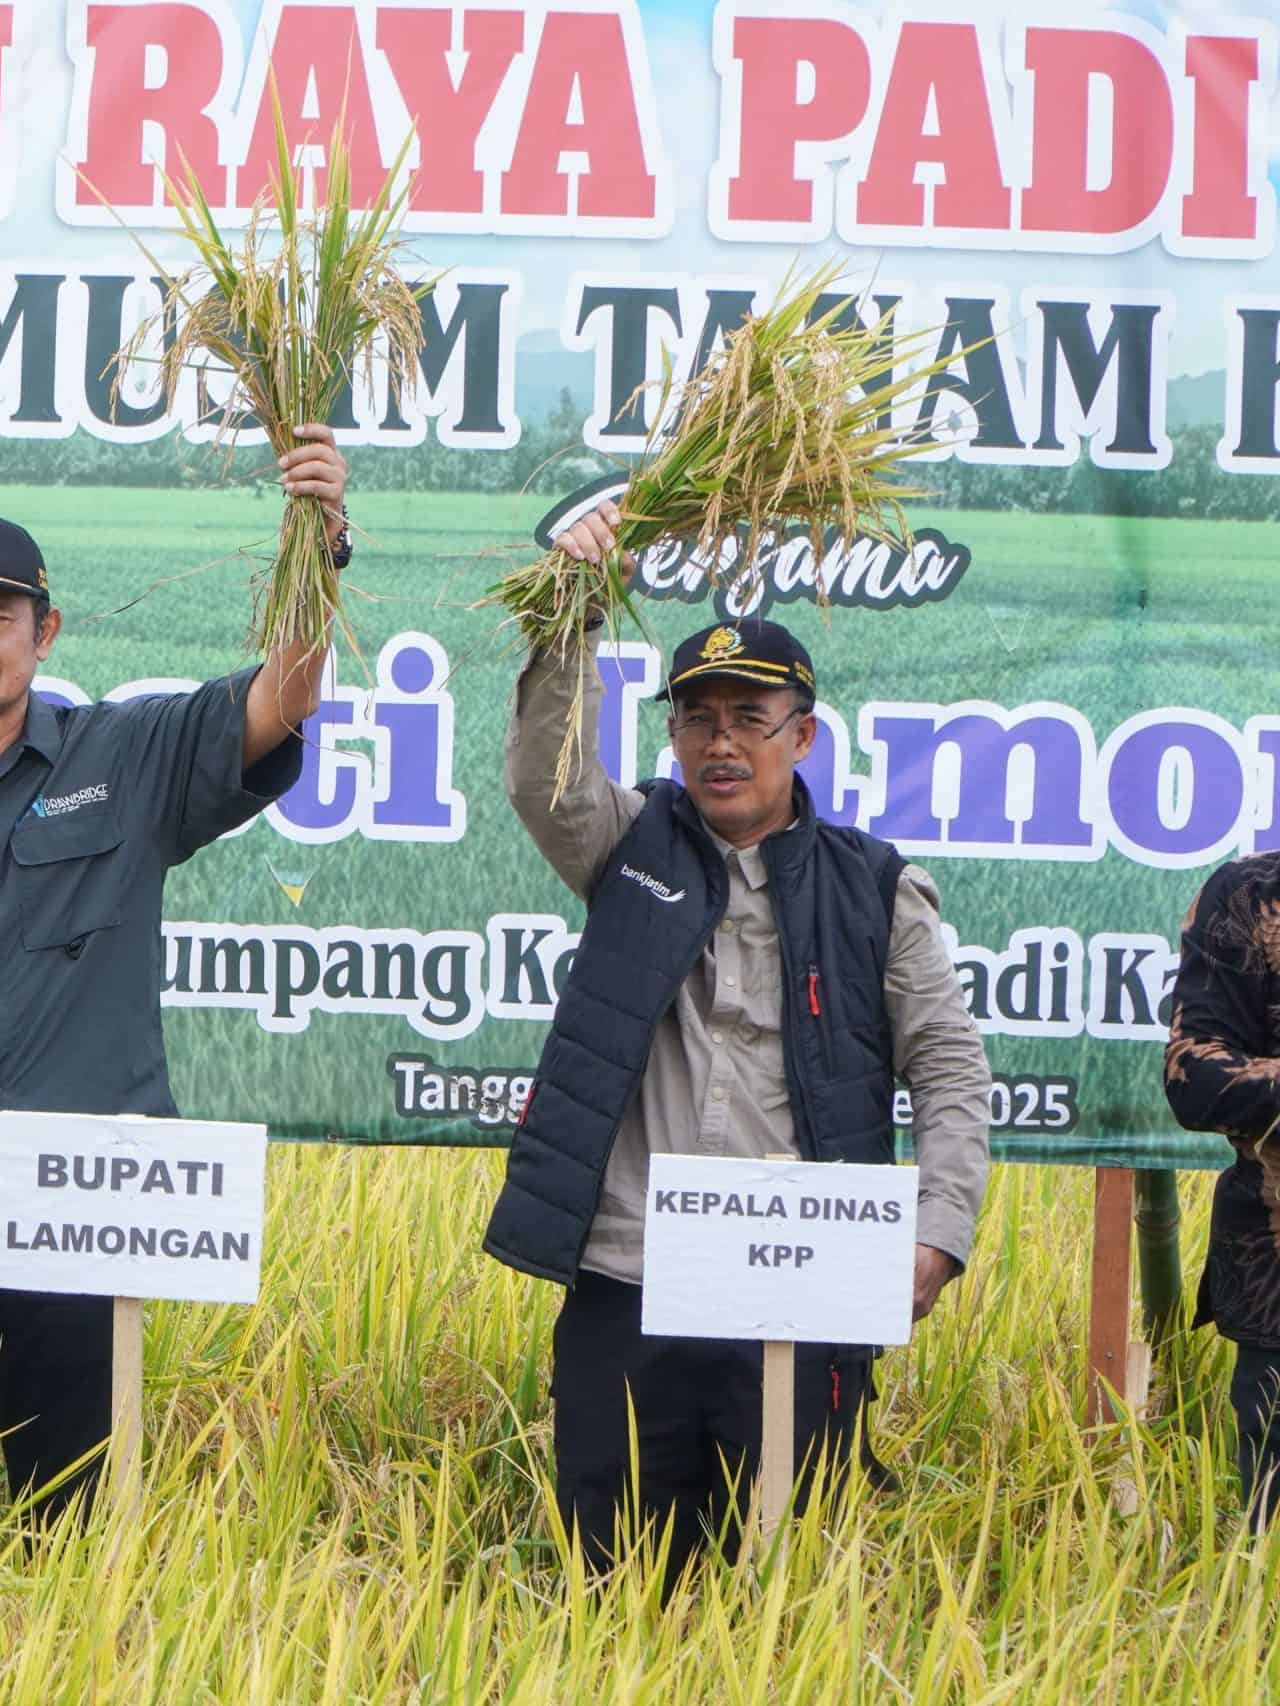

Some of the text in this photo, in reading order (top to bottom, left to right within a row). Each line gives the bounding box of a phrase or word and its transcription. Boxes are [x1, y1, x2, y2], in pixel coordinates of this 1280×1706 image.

[75, 0, 656, 219] RAYA
[727, 16, 1259, 240] PADI
[160, 935, 471, 1026] umpang
[953, 941, 1072, 1023] adi
[395, 1061, 1070, 1126] Tangg 025
[37, 1154, 225, 1197] BUPATI
[655, 1190, 902, 1224] KEPALA DINAS
[7, 1220, 250, 1262] LAMONGAN
[748, 1243, 815, 1269] KPP
